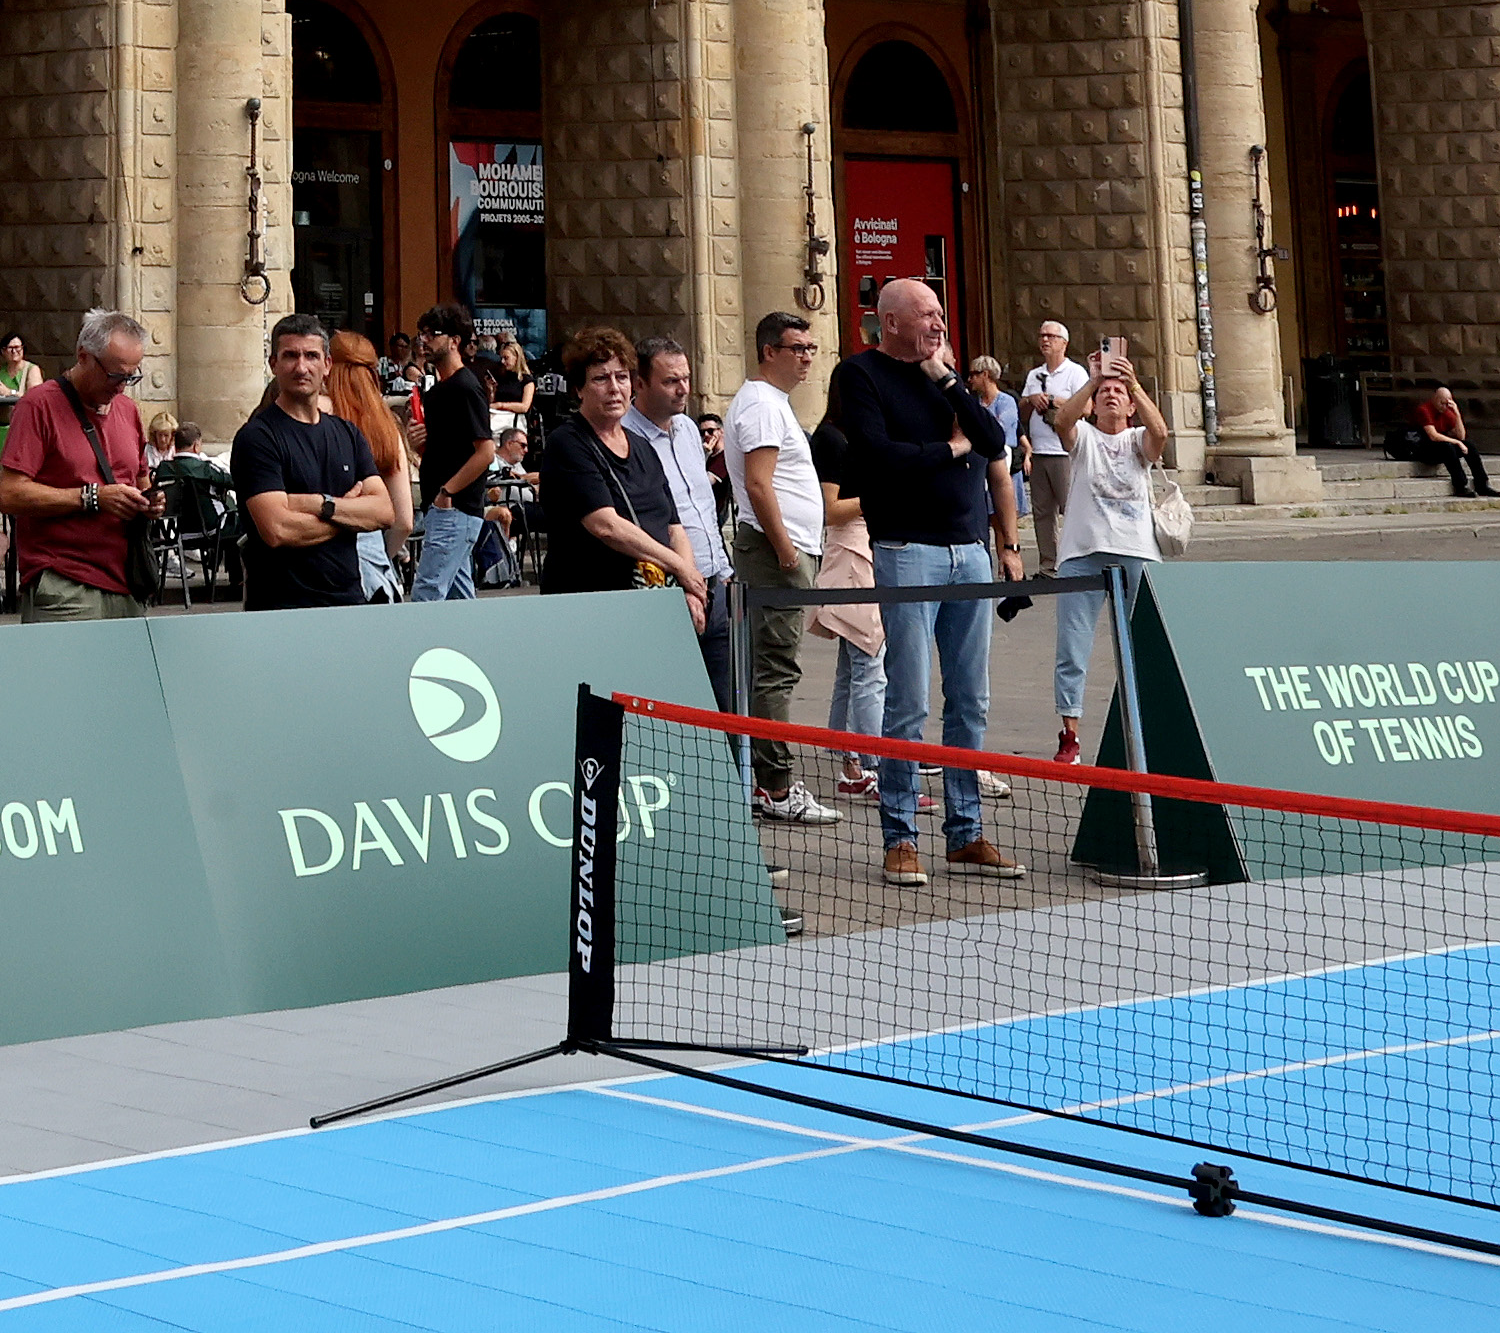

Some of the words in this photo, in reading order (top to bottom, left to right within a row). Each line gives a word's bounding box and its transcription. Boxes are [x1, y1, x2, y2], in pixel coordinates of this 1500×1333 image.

[317, 169, 360, 184] Welcome
[478, 162, 544, 181] MOHAME
[480, 213, 512, 223] PROJETS
[854, 217, 898, 231] Avvicinati
[861, 231, 898, 247] Bologna
[1244, 666, 1312, 711] THE
[1315, 661, 1433, 709] WORLD
[1436, 661, 1500, 705] CUP
[1313, 719, 1356, 765] OF
[1358, 714, 1484, 763] TENNIS
[277, 788, 510, 877] DAVIS
[576, 790, 597, 974] DUNLOP
